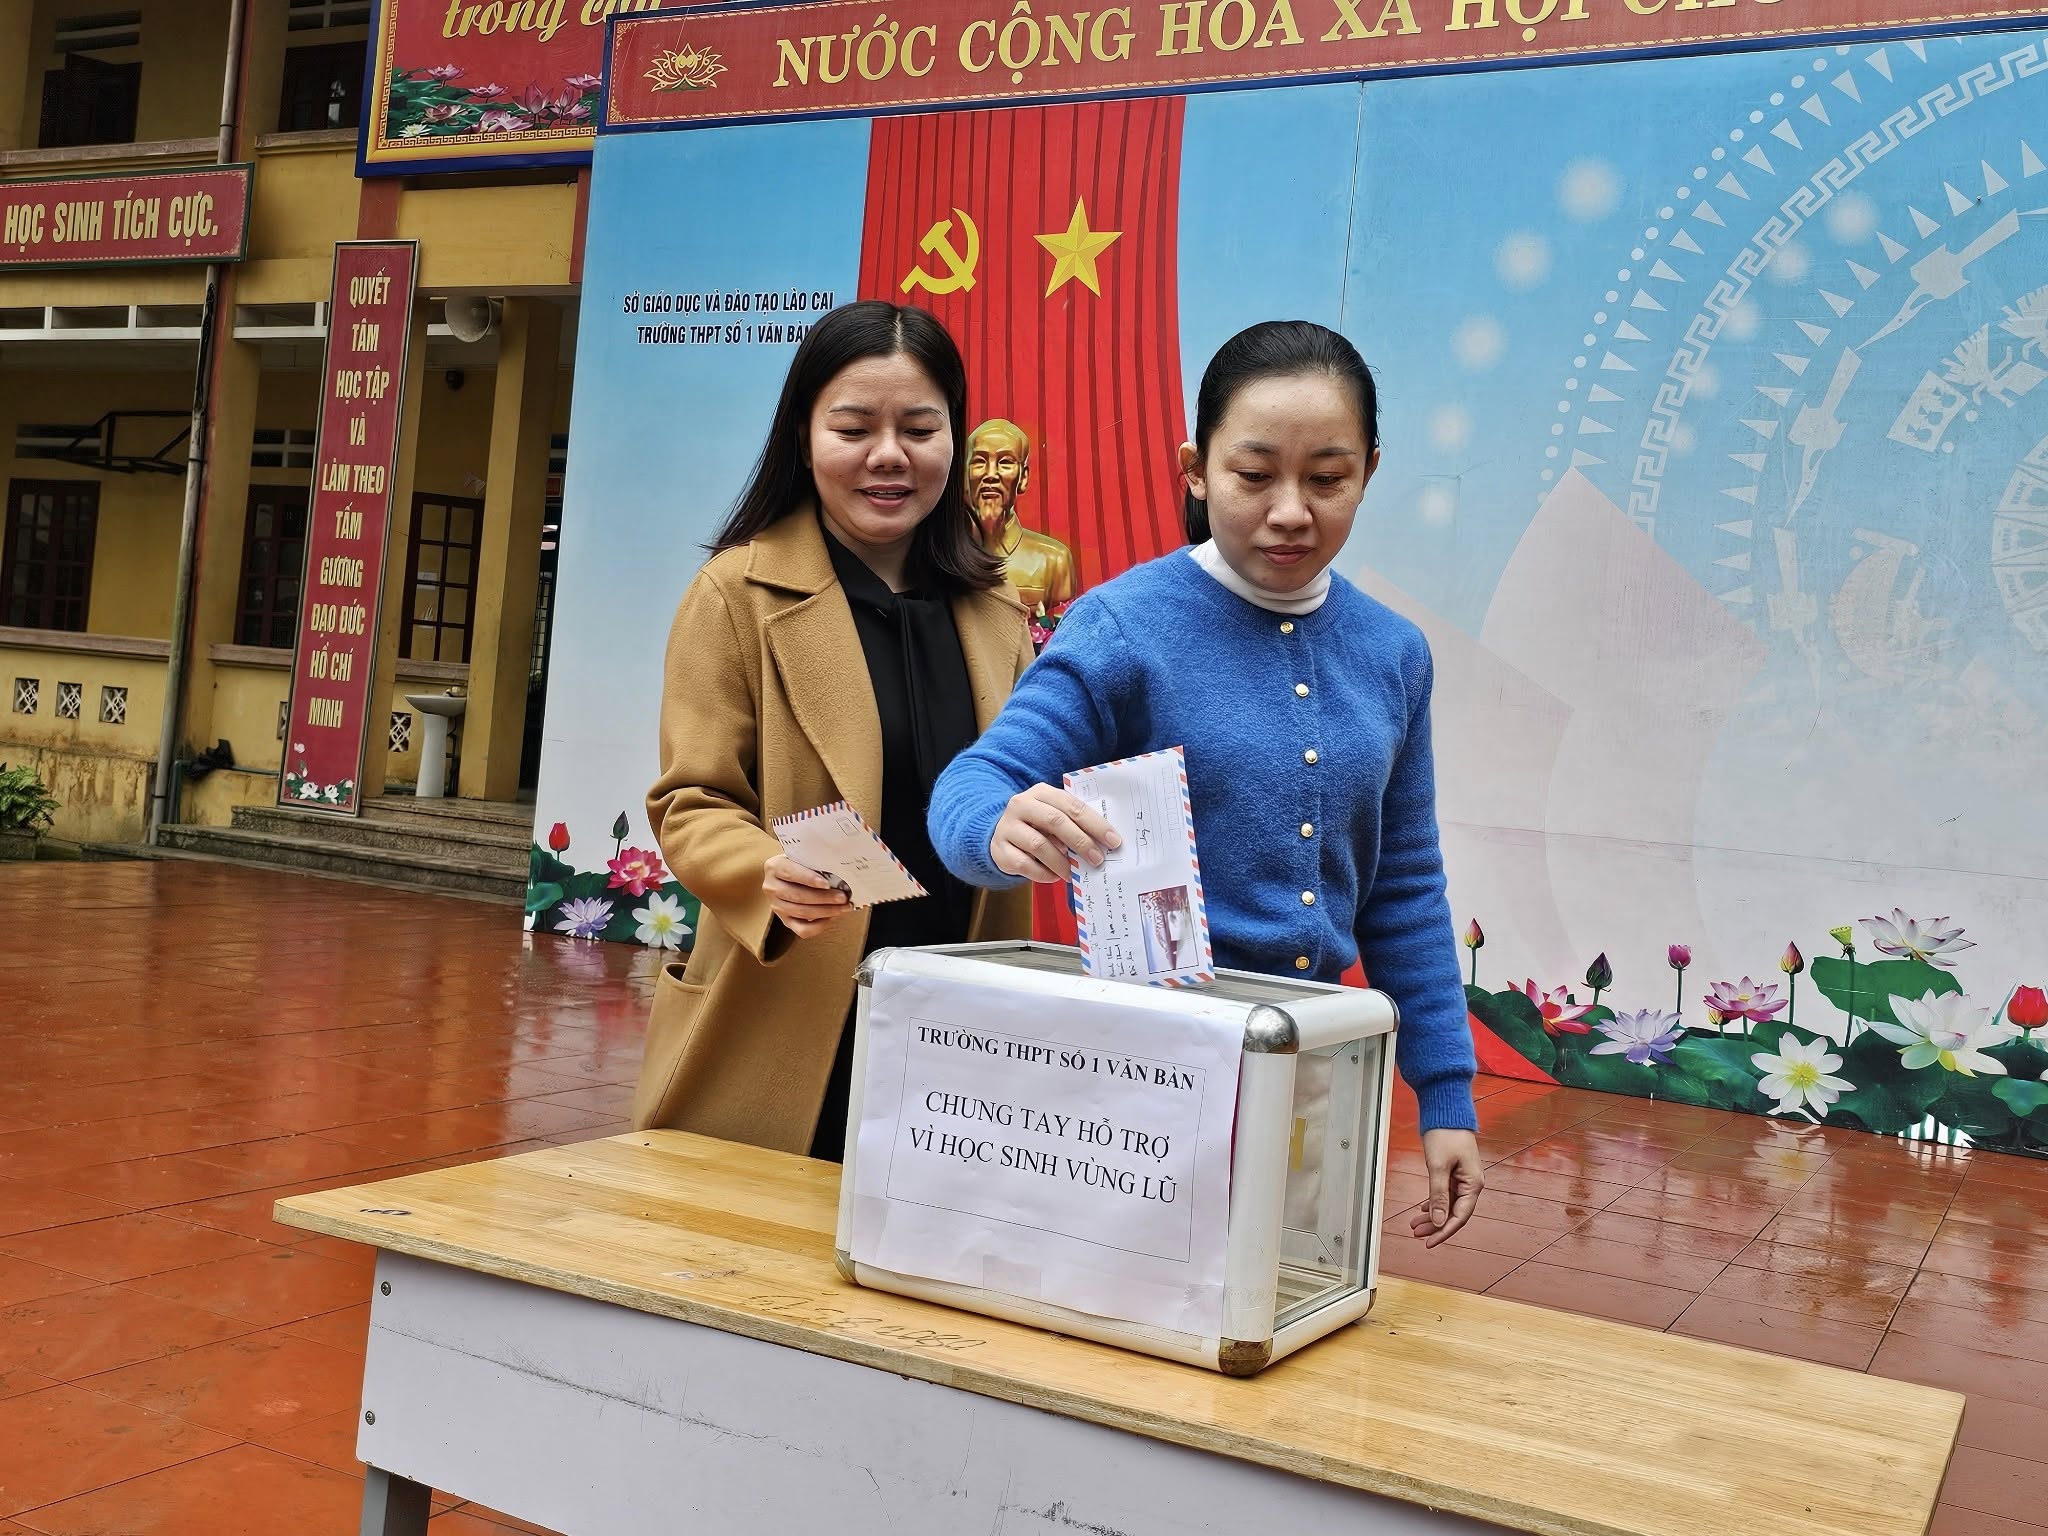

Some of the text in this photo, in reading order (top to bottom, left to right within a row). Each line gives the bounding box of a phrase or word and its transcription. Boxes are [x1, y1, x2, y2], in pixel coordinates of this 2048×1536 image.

[772, 13, 937, 88] NƯỚC
[958, 0, 1136, 85] CỘNG
[4, 190, 218, 253] HỌC SINH TÍCH CỰC.
[350, 266, 391, 308] QUYẾT
[623, 287, 834, 316] SỞ GIÁO DỤC VÀ ĐÀO TẠO LÀO CAI
[351, 317, 380, 352] TÂM
[637, 321, 686, 344] TRƯỜNG
[690, 325, 722, 344] THPT
[724, 318, 745, 344] SỐ
[745, 325, 752, 344] 1
[757, 321, 783, 344] VĂN
[335, 364, 390, 405] HỌC TẬP
[350, 411, 366, 446] VÀ
[321, 457, 385, 494] LÀM THEO
[335, 501, 363, 540] TẤM
[319, 555, 364, 588] GƯƠNG
[310, 598, 366, 638] ĐẠO ĐỨC
[330, 647, 354, 682] CHÍ
[308, 697, 344, 729] MINH
[917, 1026, 1195, 1091] TRƯỜNG THPT SỐ 1 VĂN BÀN
[925, 1091, 1170, 1163] CHUNG TAY HỖ TRỢ
[910, 1124, 1178, 1203] VÌ HỌC SINH VÙNG LŨ
